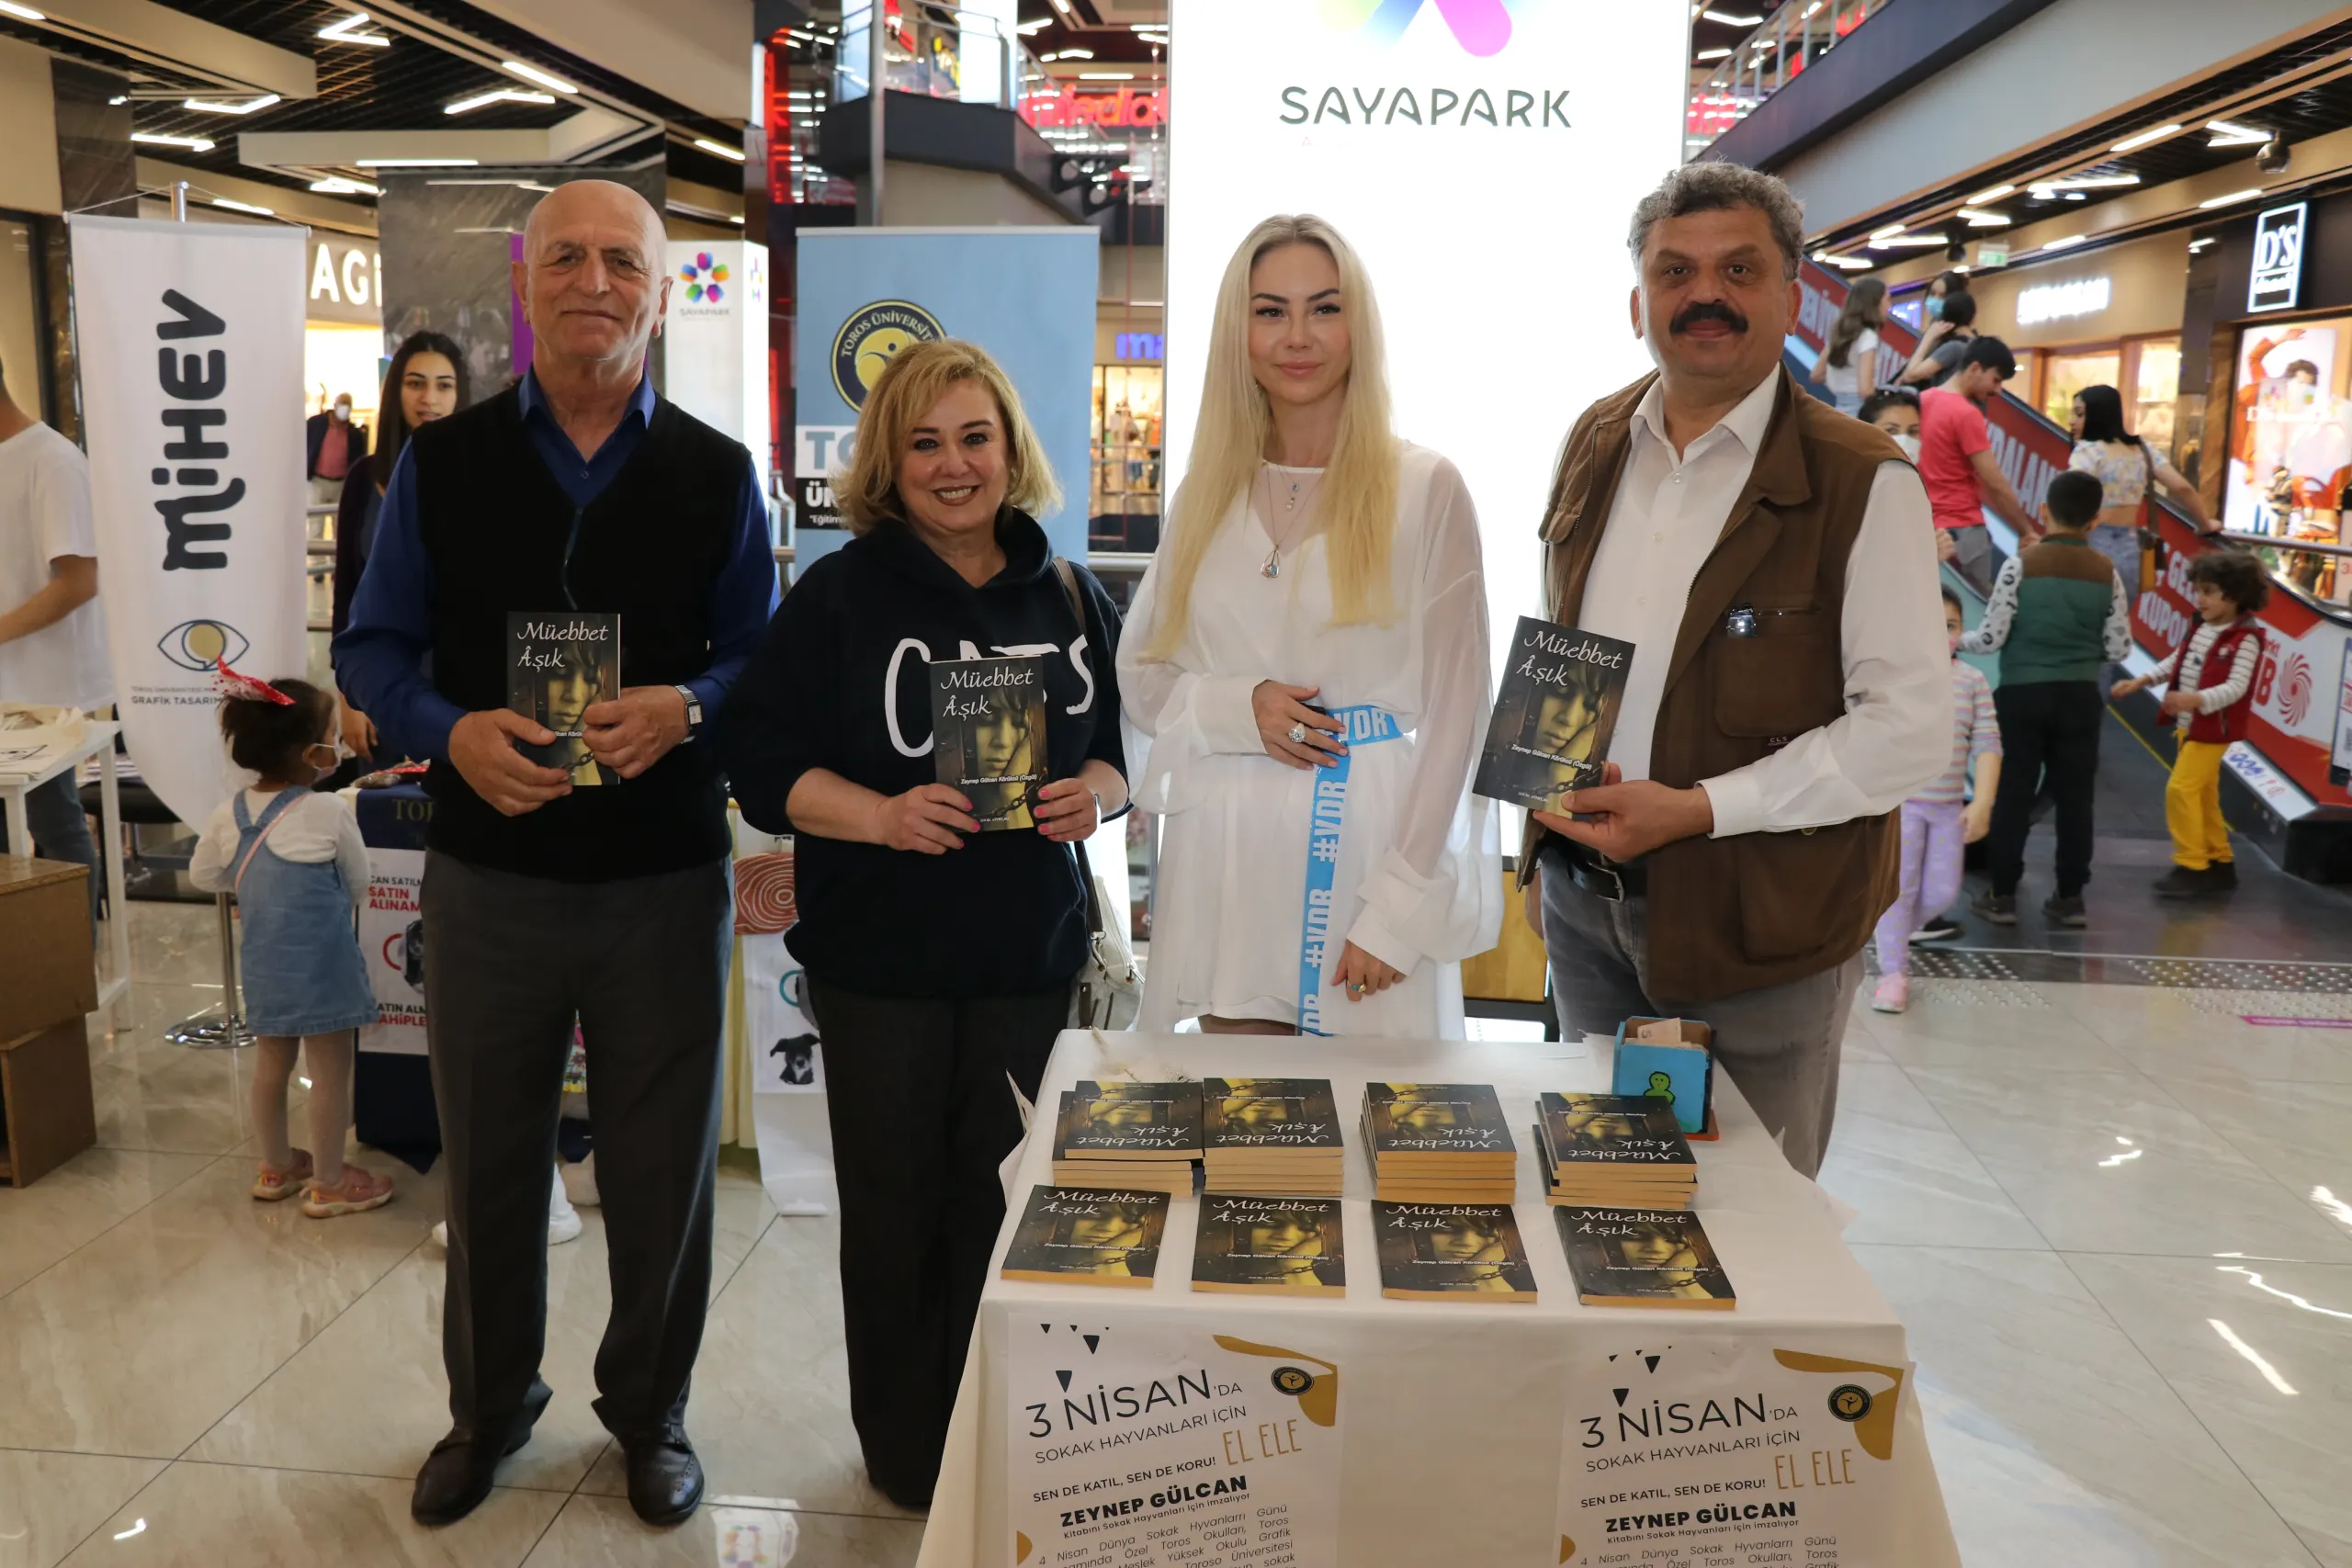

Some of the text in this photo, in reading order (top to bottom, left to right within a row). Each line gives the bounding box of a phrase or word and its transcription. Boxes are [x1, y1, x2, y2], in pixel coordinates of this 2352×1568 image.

[1279, 86, 1572, 128] SAYAPARK
[2257, 224, 2297, 270] D'S
[841, 310, 934, 358] TOROS ÜNİVERSİT
[517, 621, 609, 641] Müebbet
[517, 645, 565, 672] Âşık
[1524, 630, 1623, 670] Müebbet
[941, 666, 1035, 690] Müebbet
[1516, 654, 1567, 685] Âşık
[131, 695, 171, 705] GRAFİK
[943, 694, 992, 721] Âşık
[368, 886, 410, 898] SATIN
[378, 1003, 405, 1013] ATIN
[379, 1013, 426, 1026] AHİPLE
[1076, 1136, 1189, 1146] Müebbet
[1216, 1134, 1329, 1144] Müebbet
[1387, 1139, 1501, 1148] Müebbet
[1567, 1149, 1681, 1160] Müebbet
[1039, 1201, 1101, 1216] Âşık
[1044, 1190, 1160, 1204] Müebbet
[1213, 1200, 1329, 1213] Müebbet
[1212, 1211, 1275, 1224] Âşık
[1385, 1205, 1502, 1217] Müebbet
[1388, 1216, 1452, 1231] Âşık
[1571, 1211, 1688, 1224] Müebbet
[1577, 1223, 1638, 1236] Âşık
[1025, 1403, 1052, 1438] 3
[1580, 1416, 1605, 1449] 3
[1035, 1405, 1247, 1464] SOKAK HAYVANLARI İÇİN
[1222, 1419, 1303, 1466] EL ELE
[1586, 1430, 1801, 1472] SOKAK HAYVANLARI İÇİN
[1034, 1456, 1216, 1503] SEN DE KATIL, SEN DE KORU!
[1774, 1449, 1856, 1490] EL ELE
[1060, 1475, 1247, 1528] ZEYNEP GÜLCAN
[1580, 1479, 1766, 1508] SEN DE KATIL, SEN DE KORU!
[1064, 1493, 1250, 1539] Kitabını Sokak Hayvanları için imzalıyor
[1605, 1501, 1796, 1533] ZEYNEP GÜLCAN
[1039, 1556, 1046, 1566] 4
[1057, 1548, 1089, 1562] Nisan
[1099, 1536, 1136, 1552] Dünya
[1147, 1526, 1179, 1540] Sokak
[1257, 1505, 1287, 1517] Günü
[1125, 1545, 1148, 1559] Özel
[1161, 1537, 1191, 1551] Toros
[1259, 1517, 1289, 1529] Toros
[1607, 1518, 1799, 1544] Kitabını Sokak Hayvanları için imzalıyor
[1167, 1546, 1204, 1562] Yüksek
[1216, 1538, 1247, 1551] Okulu
[1259, 1529, 1291, 1542] Grafik
[1231, 1540, 1293, 1562] Üniversitesi
[1580, 1558, 1588, 1566] 4
[1599, 1552, 1630, 1564] Nisan
[1641, 1549, 1679, 1561] Dünya
[1690, 1544, 1723, 1555] Sokak
[1804, 1536, 1837, 1547] Günü
[1704, 1557, 1735, 1567] Toros
[1806, 1550, 1838, 1560] Toros
[1264, 1552, 1295, 1567] sokak
